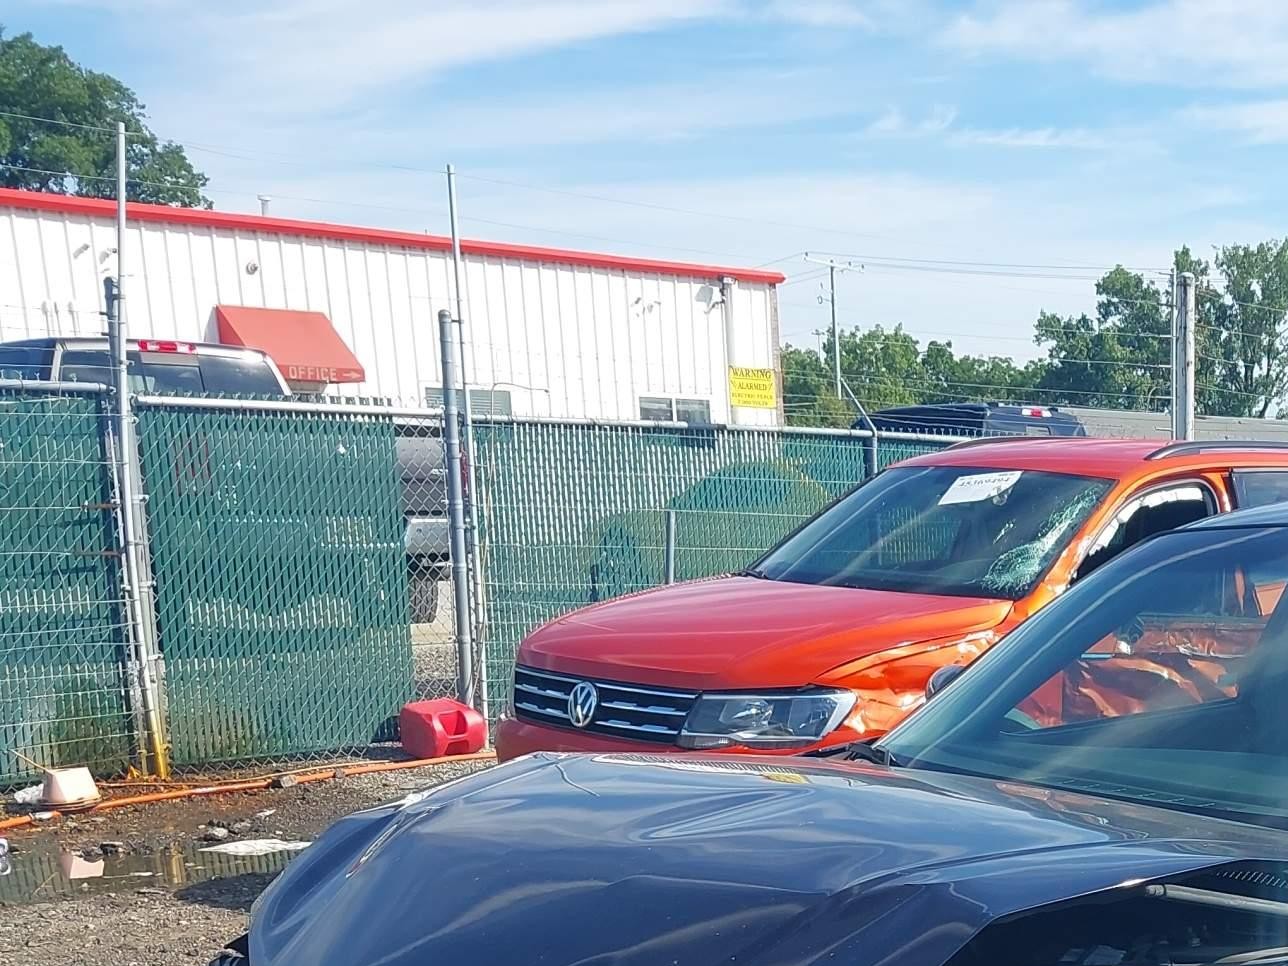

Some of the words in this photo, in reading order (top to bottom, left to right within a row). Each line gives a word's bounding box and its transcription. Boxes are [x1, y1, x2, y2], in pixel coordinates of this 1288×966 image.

[288, 366, 337, 381] OFFICE
[732, 368, 772, 379] WARNING
[738, 383, 767, 391] ALARMED
